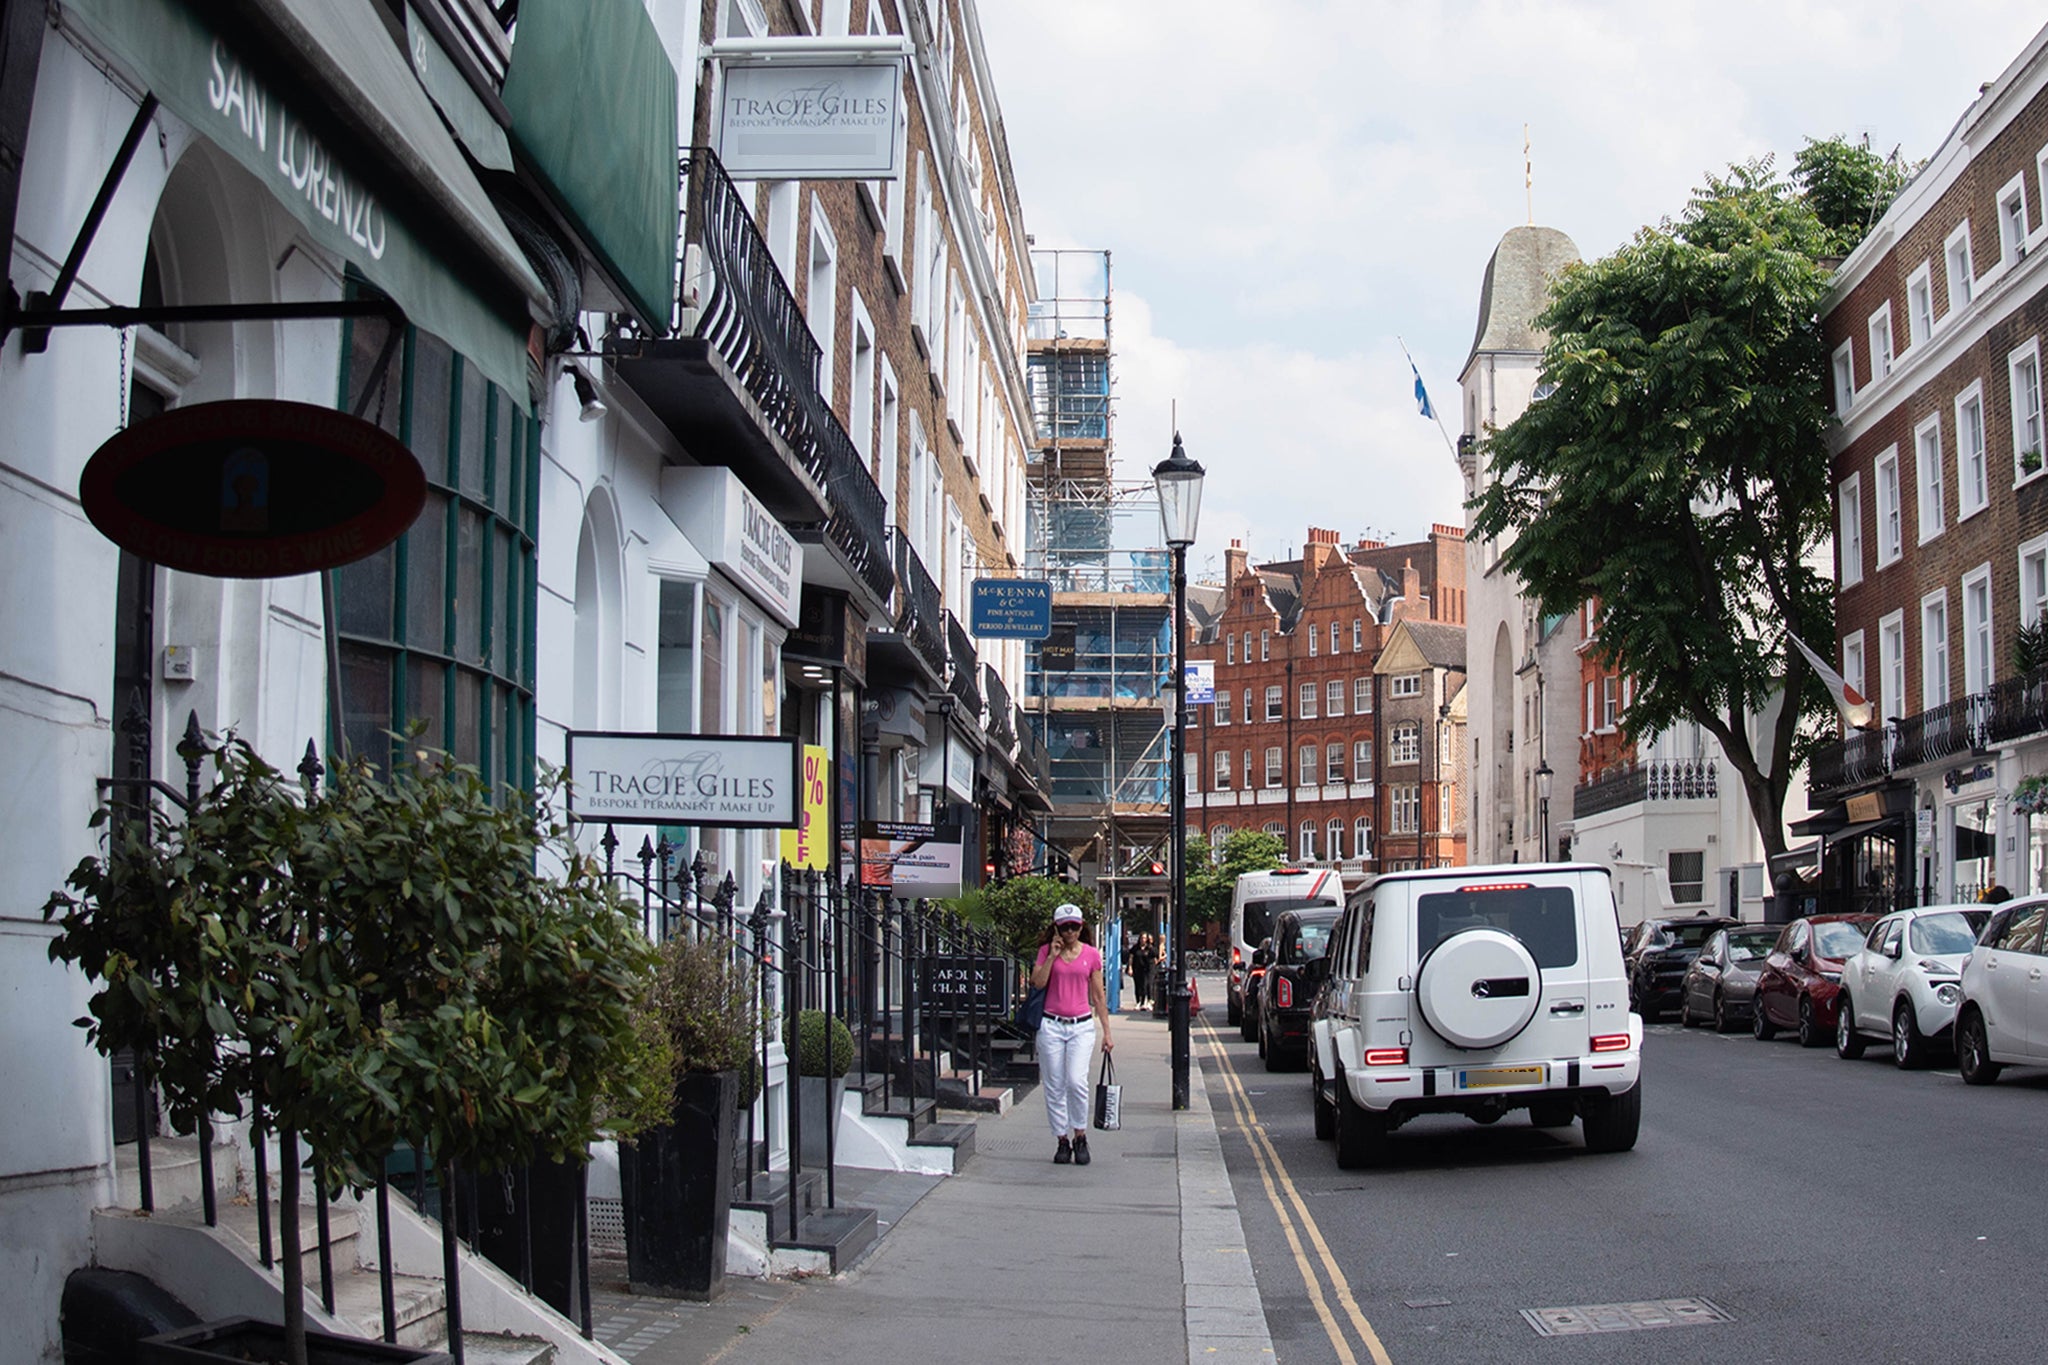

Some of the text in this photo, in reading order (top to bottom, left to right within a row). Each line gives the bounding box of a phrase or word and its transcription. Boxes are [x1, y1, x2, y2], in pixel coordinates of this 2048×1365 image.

[730, 96, 887, 116] TRACIE GILES
[729, 117, 887, 128] BESPOKE PERMANENT MAKE UP
[208, 38, 386, 260] SAN LORENZO
[231, 408, 264, 430] DEL
[269, 409, 311, 433] SAN
[315, 416, 396, 465] LORENZO
[126, 522, 197, 565] SLOW
[202, 547, 269, 571] FOOD
[299, 528, 365, 566] WINE
[999, 599, 1007, 607] &
[987, 608, 1035, 617] FINE ANTIQUE
[1004, 623, 1044, 631] JEWELLERY
[588, 770, 774, 798] TRACIE GILES
[589, 797, 775, 813] BESPOKE PERMANENT MAKE UP
[892, 824, 935, 832] THERAPEUTICS
